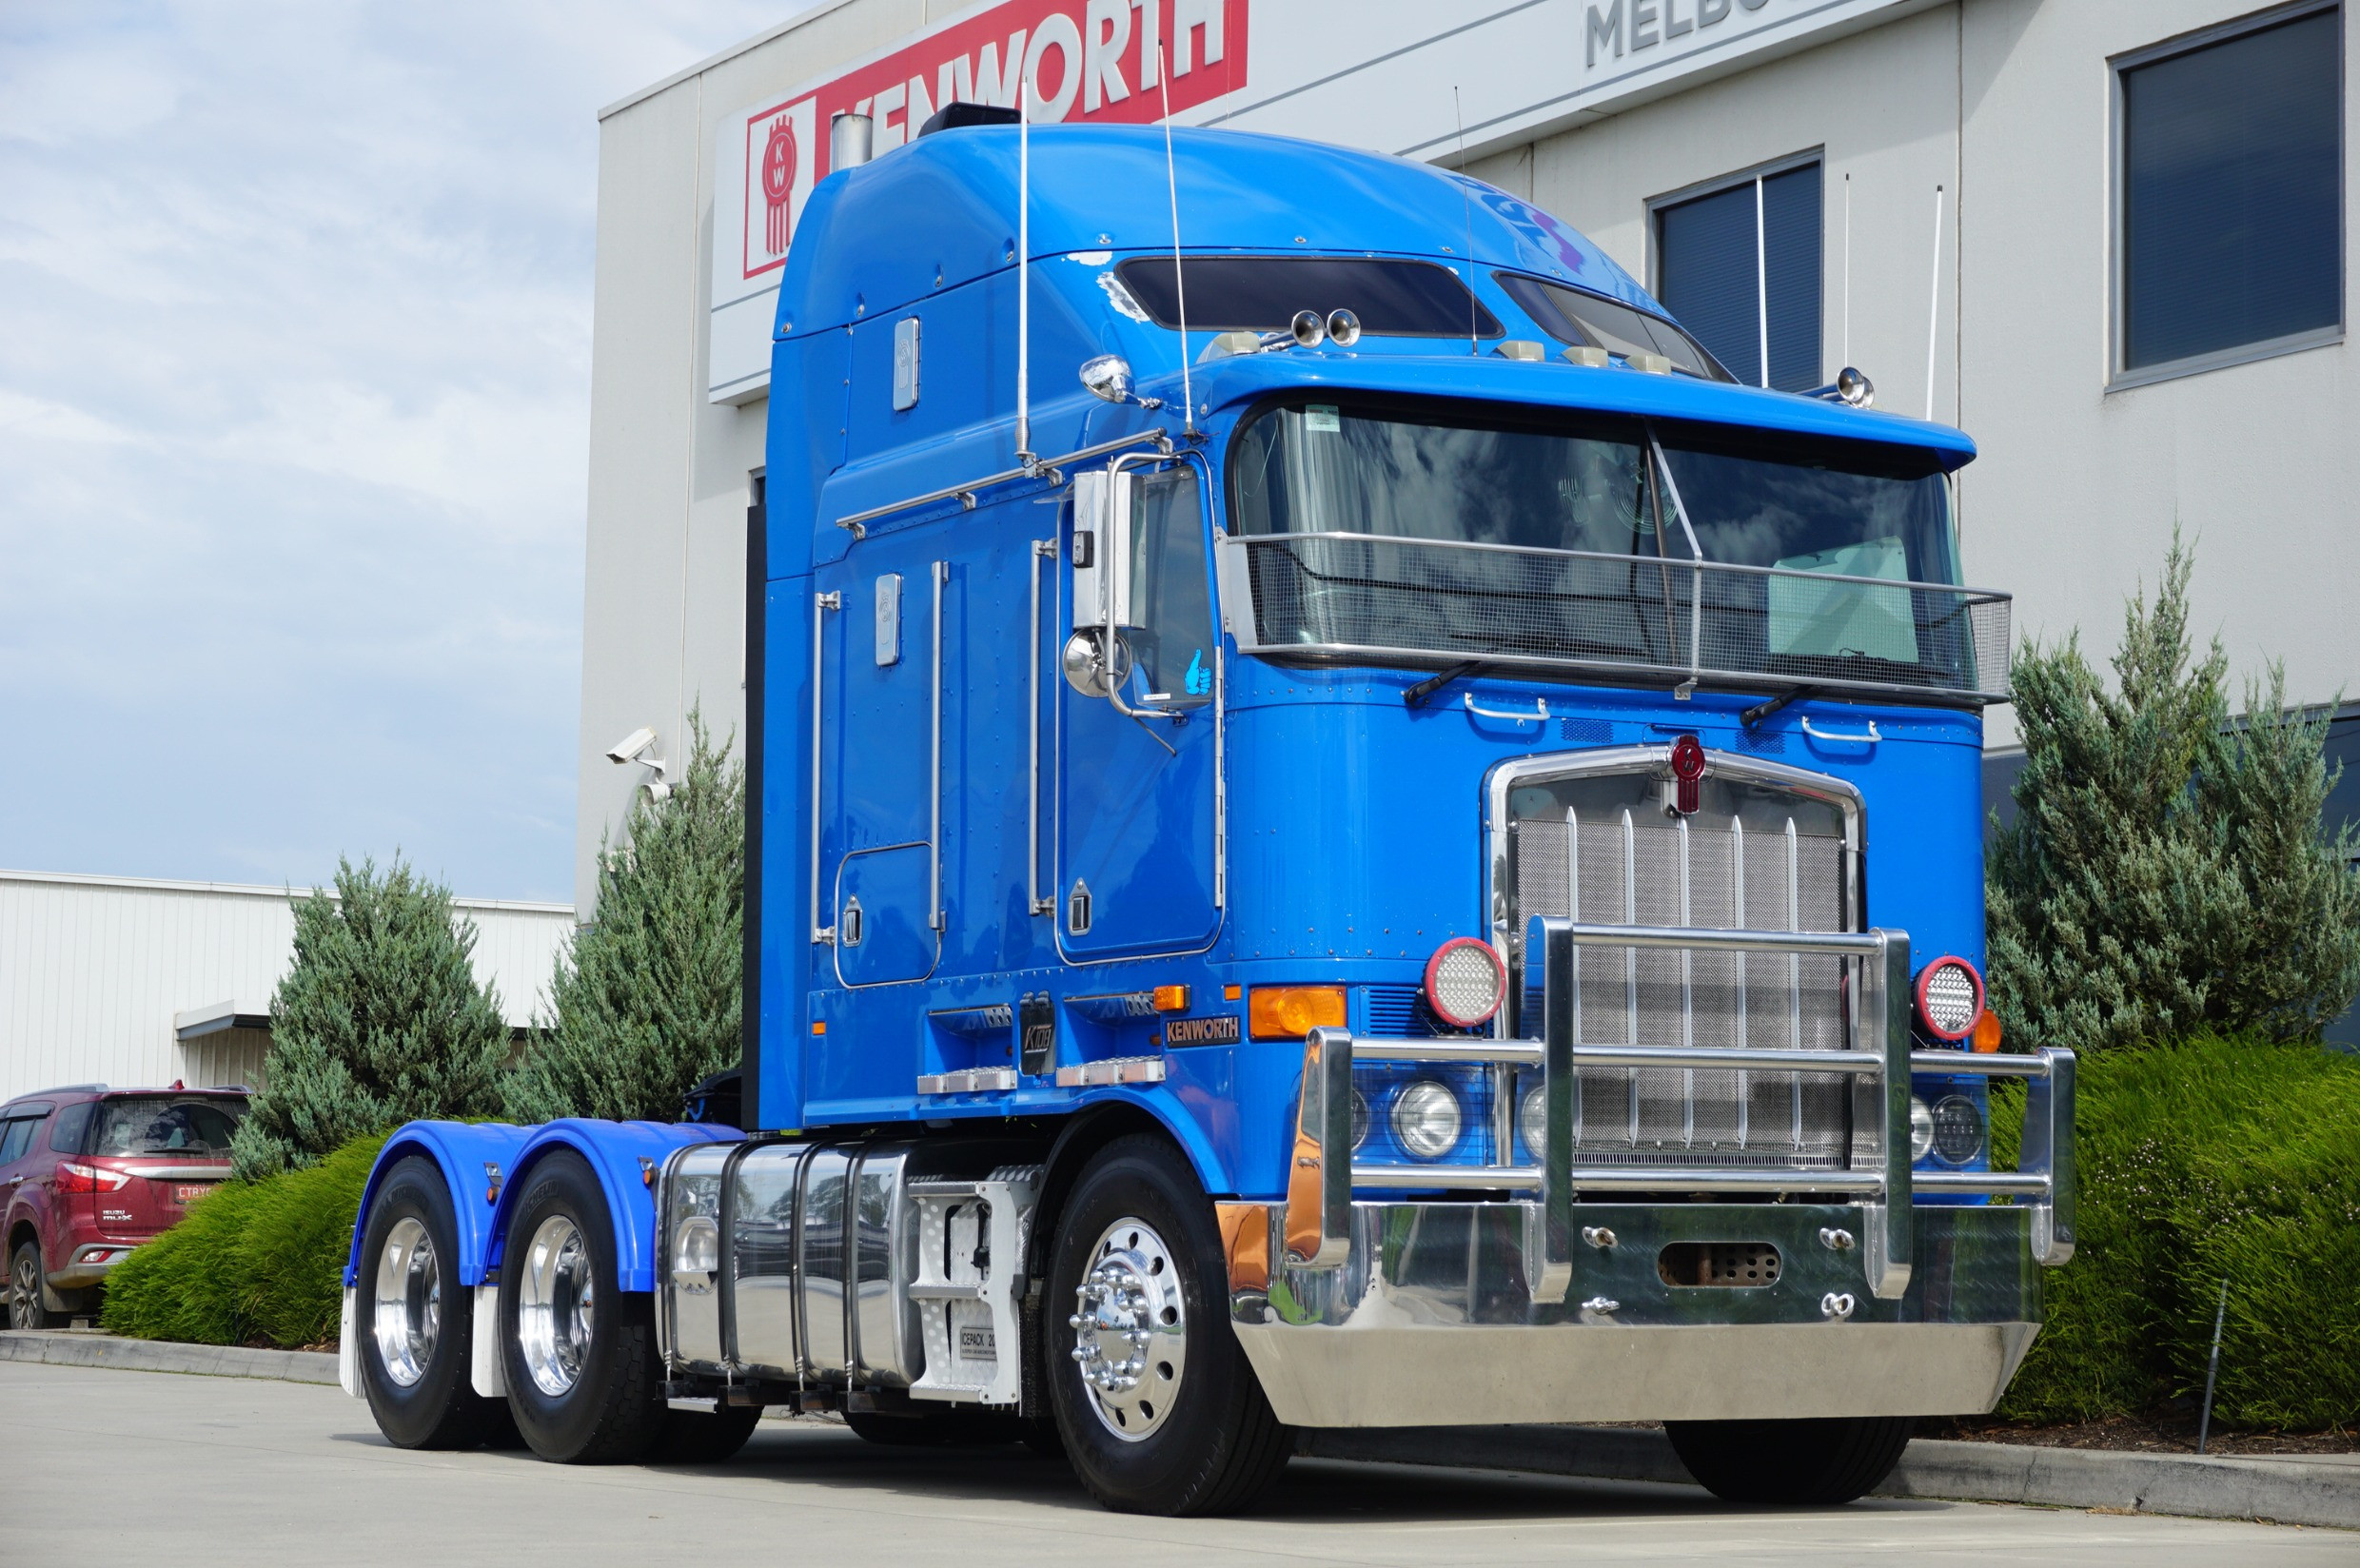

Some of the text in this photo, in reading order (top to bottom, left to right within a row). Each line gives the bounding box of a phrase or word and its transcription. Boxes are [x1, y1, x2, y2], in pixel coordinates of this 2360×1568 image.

[1586, 0, 1768, 68] MEL
[830, 0, 1224, 162] ENWORTH
[776, 141, 784, 164] K
[773, 165, 786, 188] W
[1167, 1017, 1239, 1042] KENWORTH
[178, 1186, 215, 1198] CTRYC
[961, 1332, 984, 1346] ICEPACK
